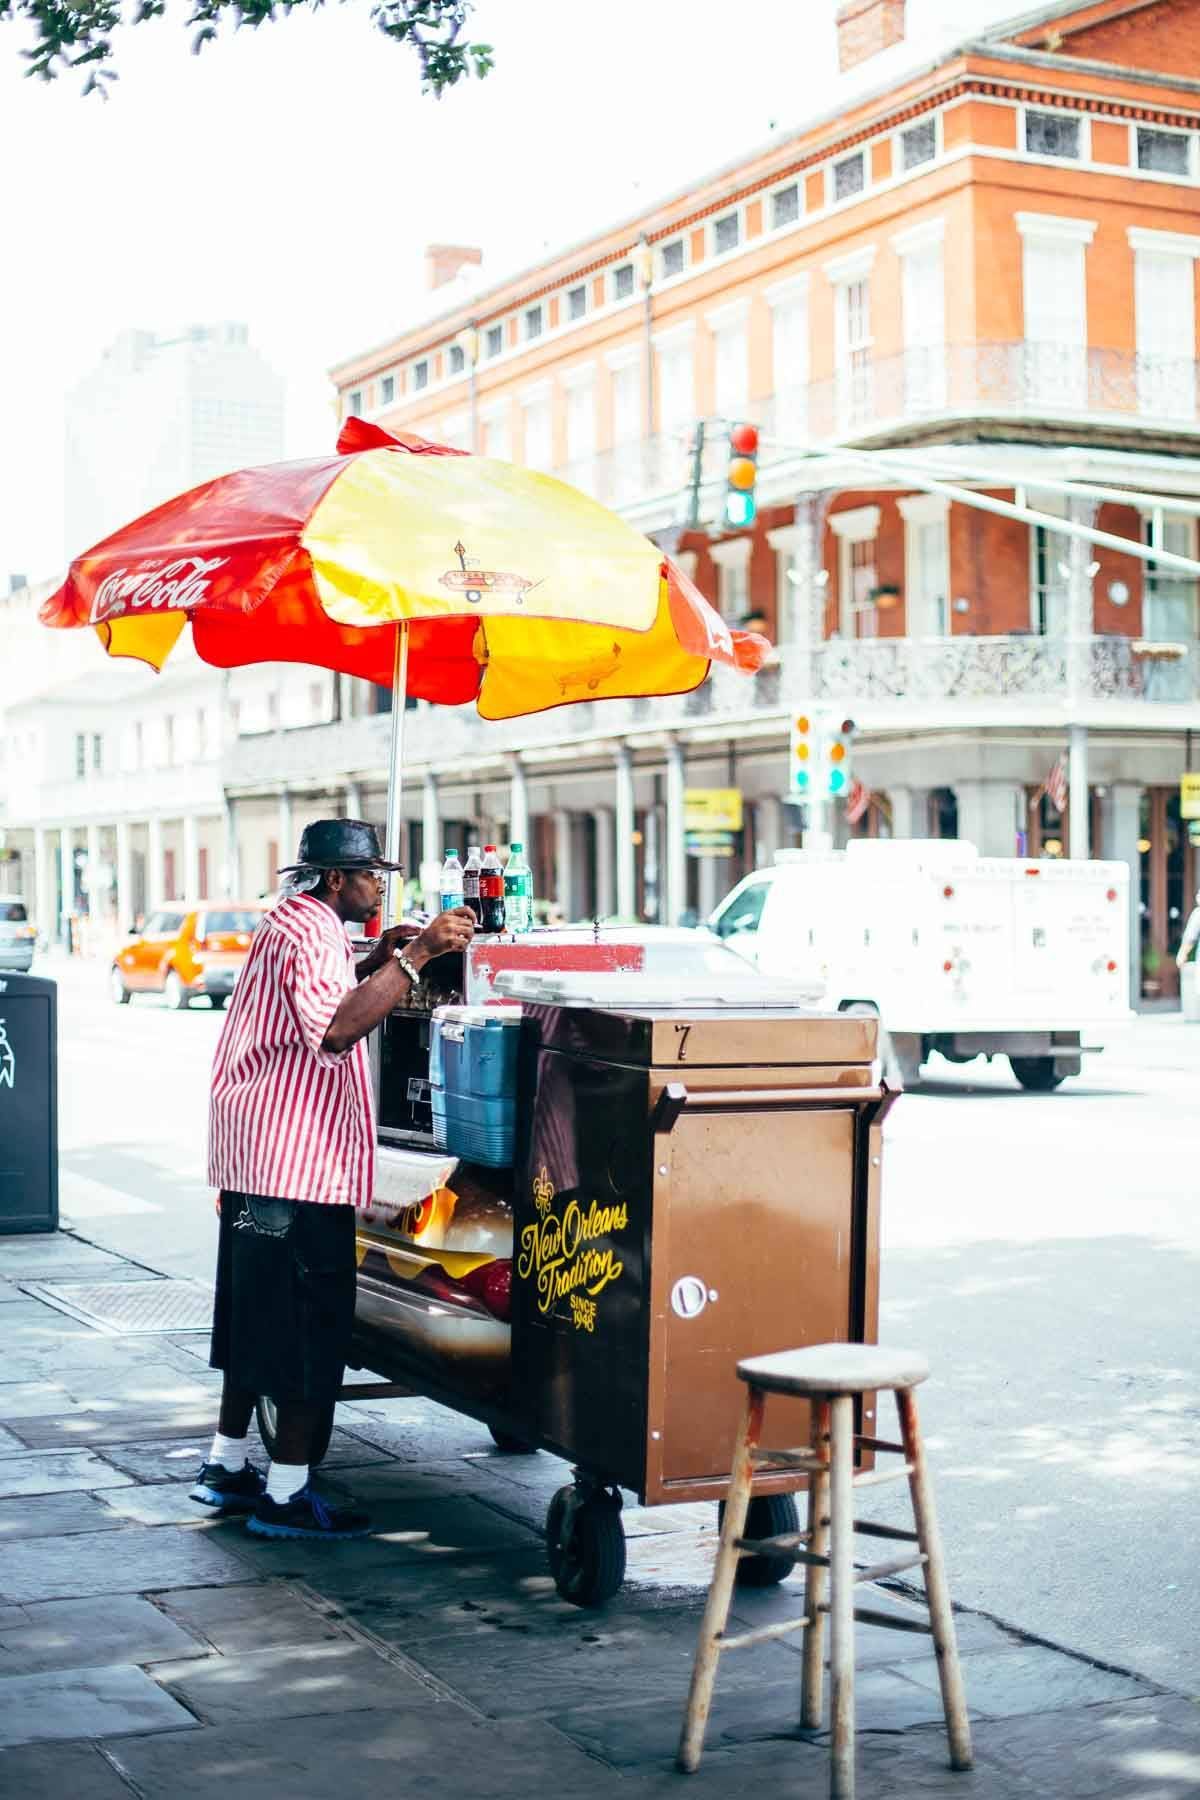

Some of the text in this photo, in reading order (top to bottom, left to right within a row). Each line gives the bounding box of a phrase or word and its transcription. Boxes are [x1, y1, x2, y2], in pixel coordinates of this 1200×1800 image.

[674, 1024, 691, 1061] 7
[518, 1200, 628, 1279] New Orleans
[538, 1248, 624, 1312] Tradition
[570, 1294, 597, 1317] SINCE
[573, 1311, 595, 1333] 1948
